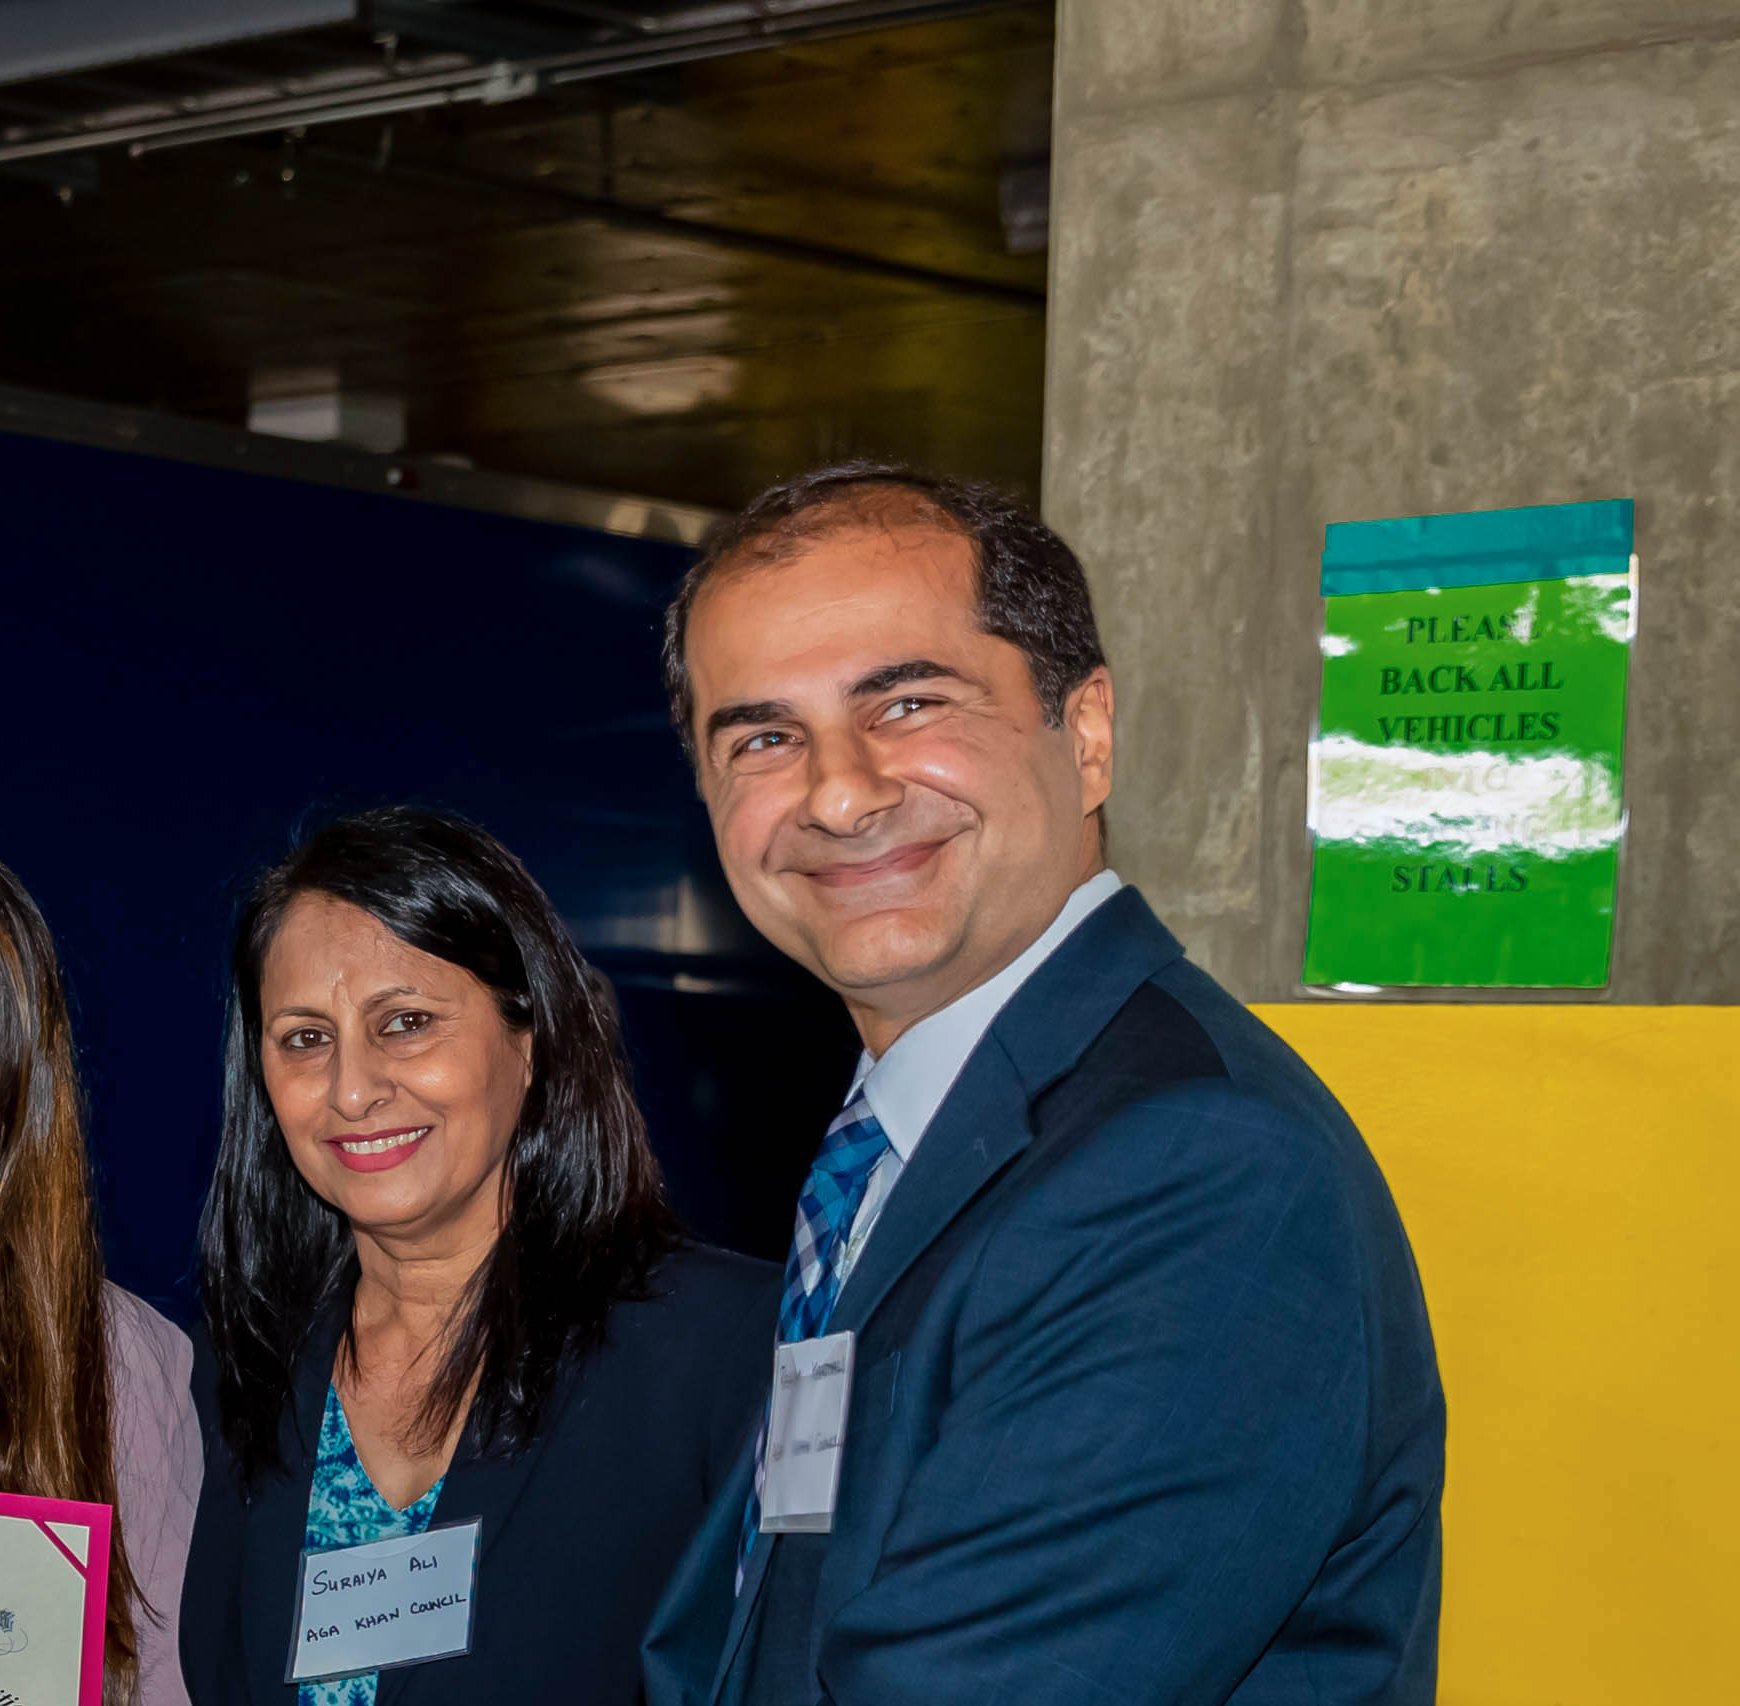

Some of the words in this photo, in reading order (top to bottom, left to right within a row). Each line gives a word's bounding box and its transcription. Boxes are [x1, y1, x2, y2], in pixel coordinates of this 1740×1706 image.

[1379, 664, 1478, 696] BACK
[1490, 662, 1564, 691] ALL
[1378, 712, 1559, 744] VEHICLES
[311, 1568, 388, 1596] SURAIYA
[410, 1555, 438, 1572] ALI
[306, 1625, 340, 1642] AGA
[355, 1608, 400, 1631] KHAN
